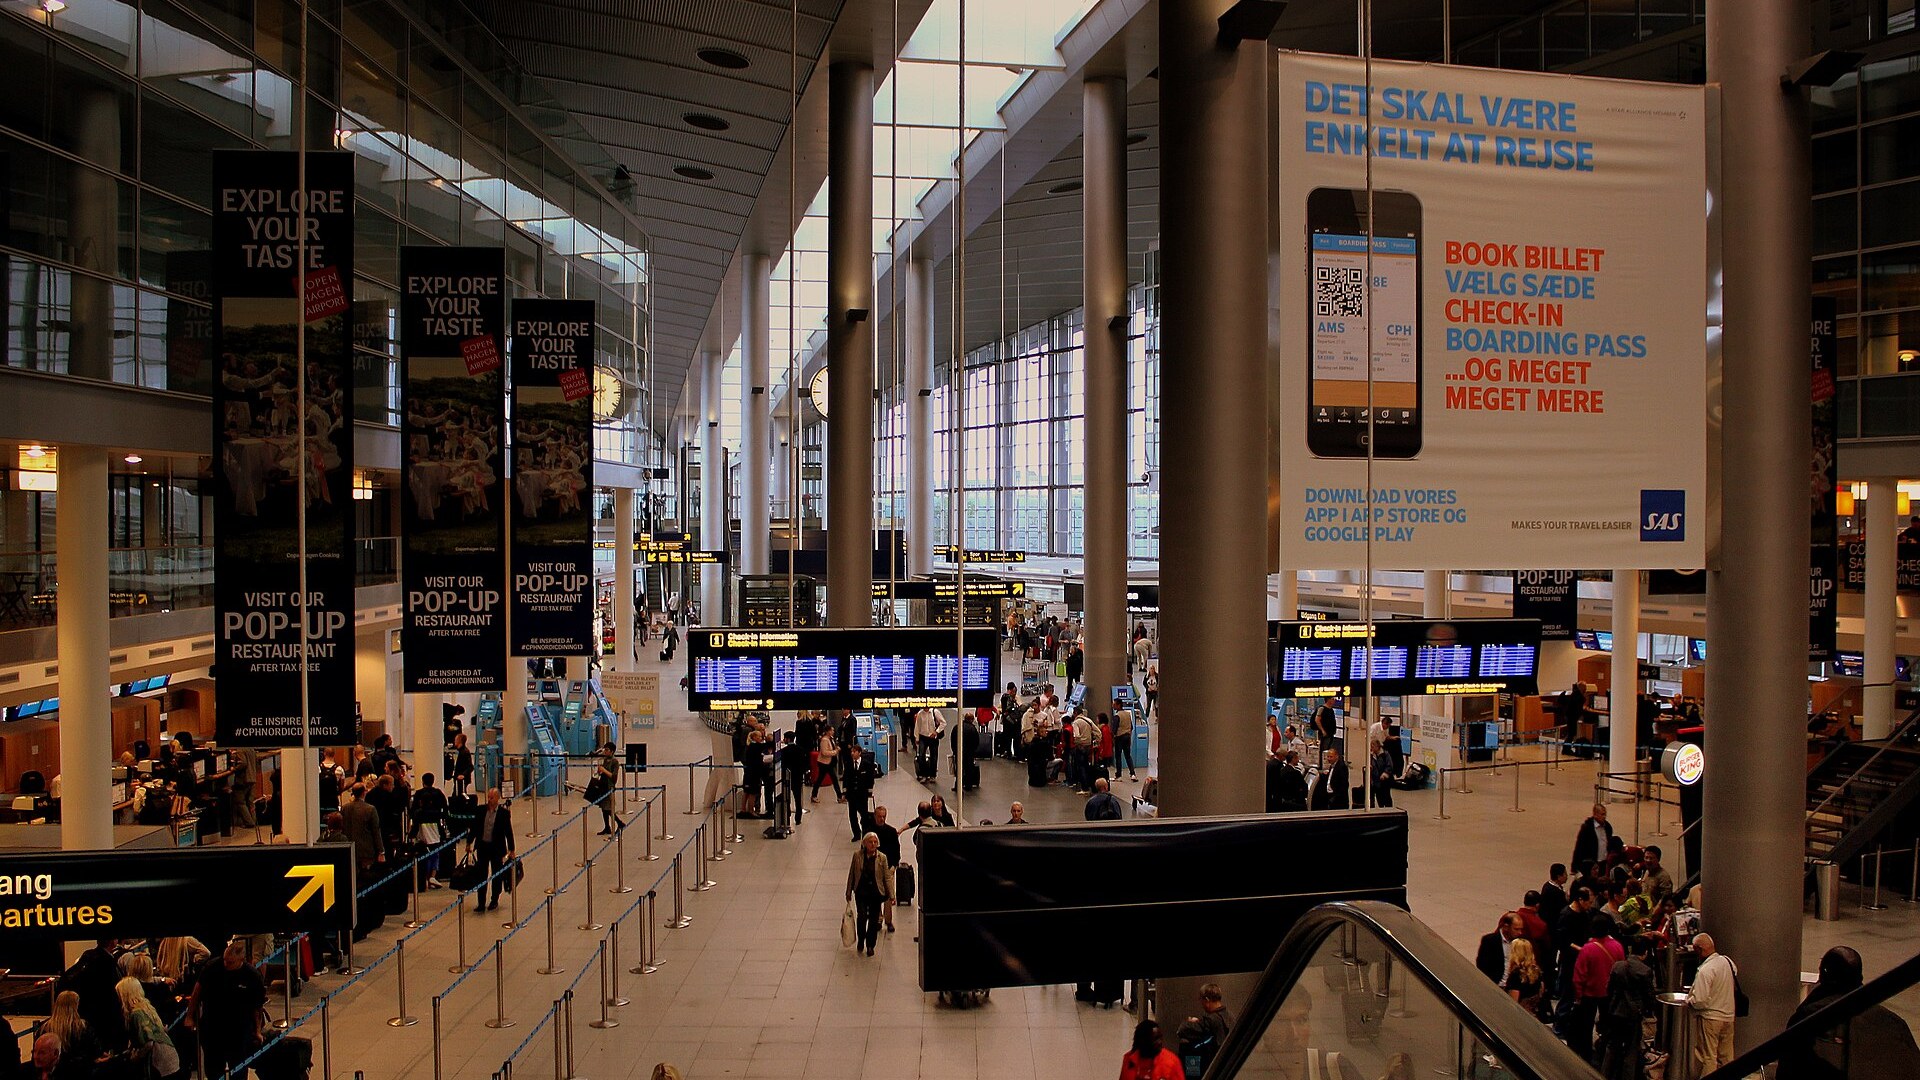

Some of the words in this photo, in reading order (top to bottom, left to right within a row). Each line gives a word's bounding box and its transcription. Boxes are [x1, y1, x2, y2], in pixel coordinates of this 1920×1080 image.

[1305, 81, 1374, 116] DET
[1382, 88, 1474, 124] SKAL
[1480, 96, 1576, 132] VÆRE
[1305, 121, 1435, 161] ENKELT
[1443, 132, 1486, 164] AT
[1496, 136, 1594, 172] REJSE
[223, 188, 344, 213] EXPLORE
[247, 216, 320, 241] YOUR
[242, 244, 324, 269] TASTE
[1446, 241, 1518, 268] BOOK
[1525, 245, 1604, 272] BILLET
[408, 276, 498, 295] EXPLORE
[1445, 269, 1516, 296] VÆLG
[1522, 273, 1595, 299] SÆDE
[426, 297, 480, 315] YOUR
[1445, 299, 1563, 327] CHECK-IN
[422, 317, 483, 336] TASTE
[517, 320, 589, 337] EXPLORE
[1318, 322, 1345, 333] AMS
[1387, 325, 1412, 335] CPH
[463, 338, 493, 353] COPEN
[531, 338, 575, 353] YOUR
[1446, 328, 1578, 355] BOARDING
[1585, 333, 1647, 358] PASS
[467, 348, 496, 362] HAGEN
[528, 354, 577, 370] TASTE
[1445, 357, 1501, 381] ...OG
[1508, 359, 1591, 384] MEGET
[1446, 386, 1530, 411] MEGET
[1537, 389, 1604, 413] MERE
[1305, 488, 1401, 504] DOWNLOAD
[1404, 489, 1457, 505] VORES
[1305, 508, 1338, 523] APP
[1342, 508, 1347, 522] I
[1351, 508, 1383, 523] APP
[1387, 508, 1440, 523] STORE
[1444, 509, 1467, 524] OG
[1643, 512, 1682, 531] SAS
[1511, 520, 1542, 530] MAKES
[1543, 521, 1567, 530] YOUR
[1568, 521, 1600, 531] TRAVEL
[1601, 522, 1632, 531] EASIER
[1304, 527, 1369, 542] GOOGLE
[1375, 527, 1414, 542] PLAY
[984, 552, 989, 562] 1
[528, 562, 553, 572] VISIT
[555, 562, 576, 572] OUR
[424, 576, 455, 588] VISIT
[458, 576, 483, 588] OUR
[515, 574, 589, 592] POP-UP
[1517, 570, 1573, 585] POP-UP
[520, 593, 583, 604] RESTAURANT
[1520, 586, 1569, 595] RESTAURANT
[244, 591, 286, 607] VISIT
[290, 591, 324, 607] OUR
[409, 590, 499, 613] POP-UP
[224, 611, 346, 640] POP-UP
[415, 615, 492, 627] RESTAURANT
[428, 629, 449, 637] AFTER
[728, 632, 758, 640] Check-in
[760, 632, 798, 640] Information
[232, 643, 336, 658] RESTAURANT
[728, 639, 758, 648] Check-in
[759, 639, 798, 647] Information
[250, 663, 278, 672] AFTER
[280, 663, 296, 672] TAX
[429, 669, 439, 677] BE
[439, 669, 471, 677] INSPIRED
[417, 677, 494, 685] #CPHNORDICDINING13
[1343, 685, 1351, 696] 3
[766, 698, 774, 710] 3
[251, 717, 263, 726] BE
[310, 716, 322, 725] AT
[633, 717, 654, 725] PLUS
[1680, 758, 1701, 776] KING
[0, 874, 52, 900] ang
[0, 903, 113, 928] artures
